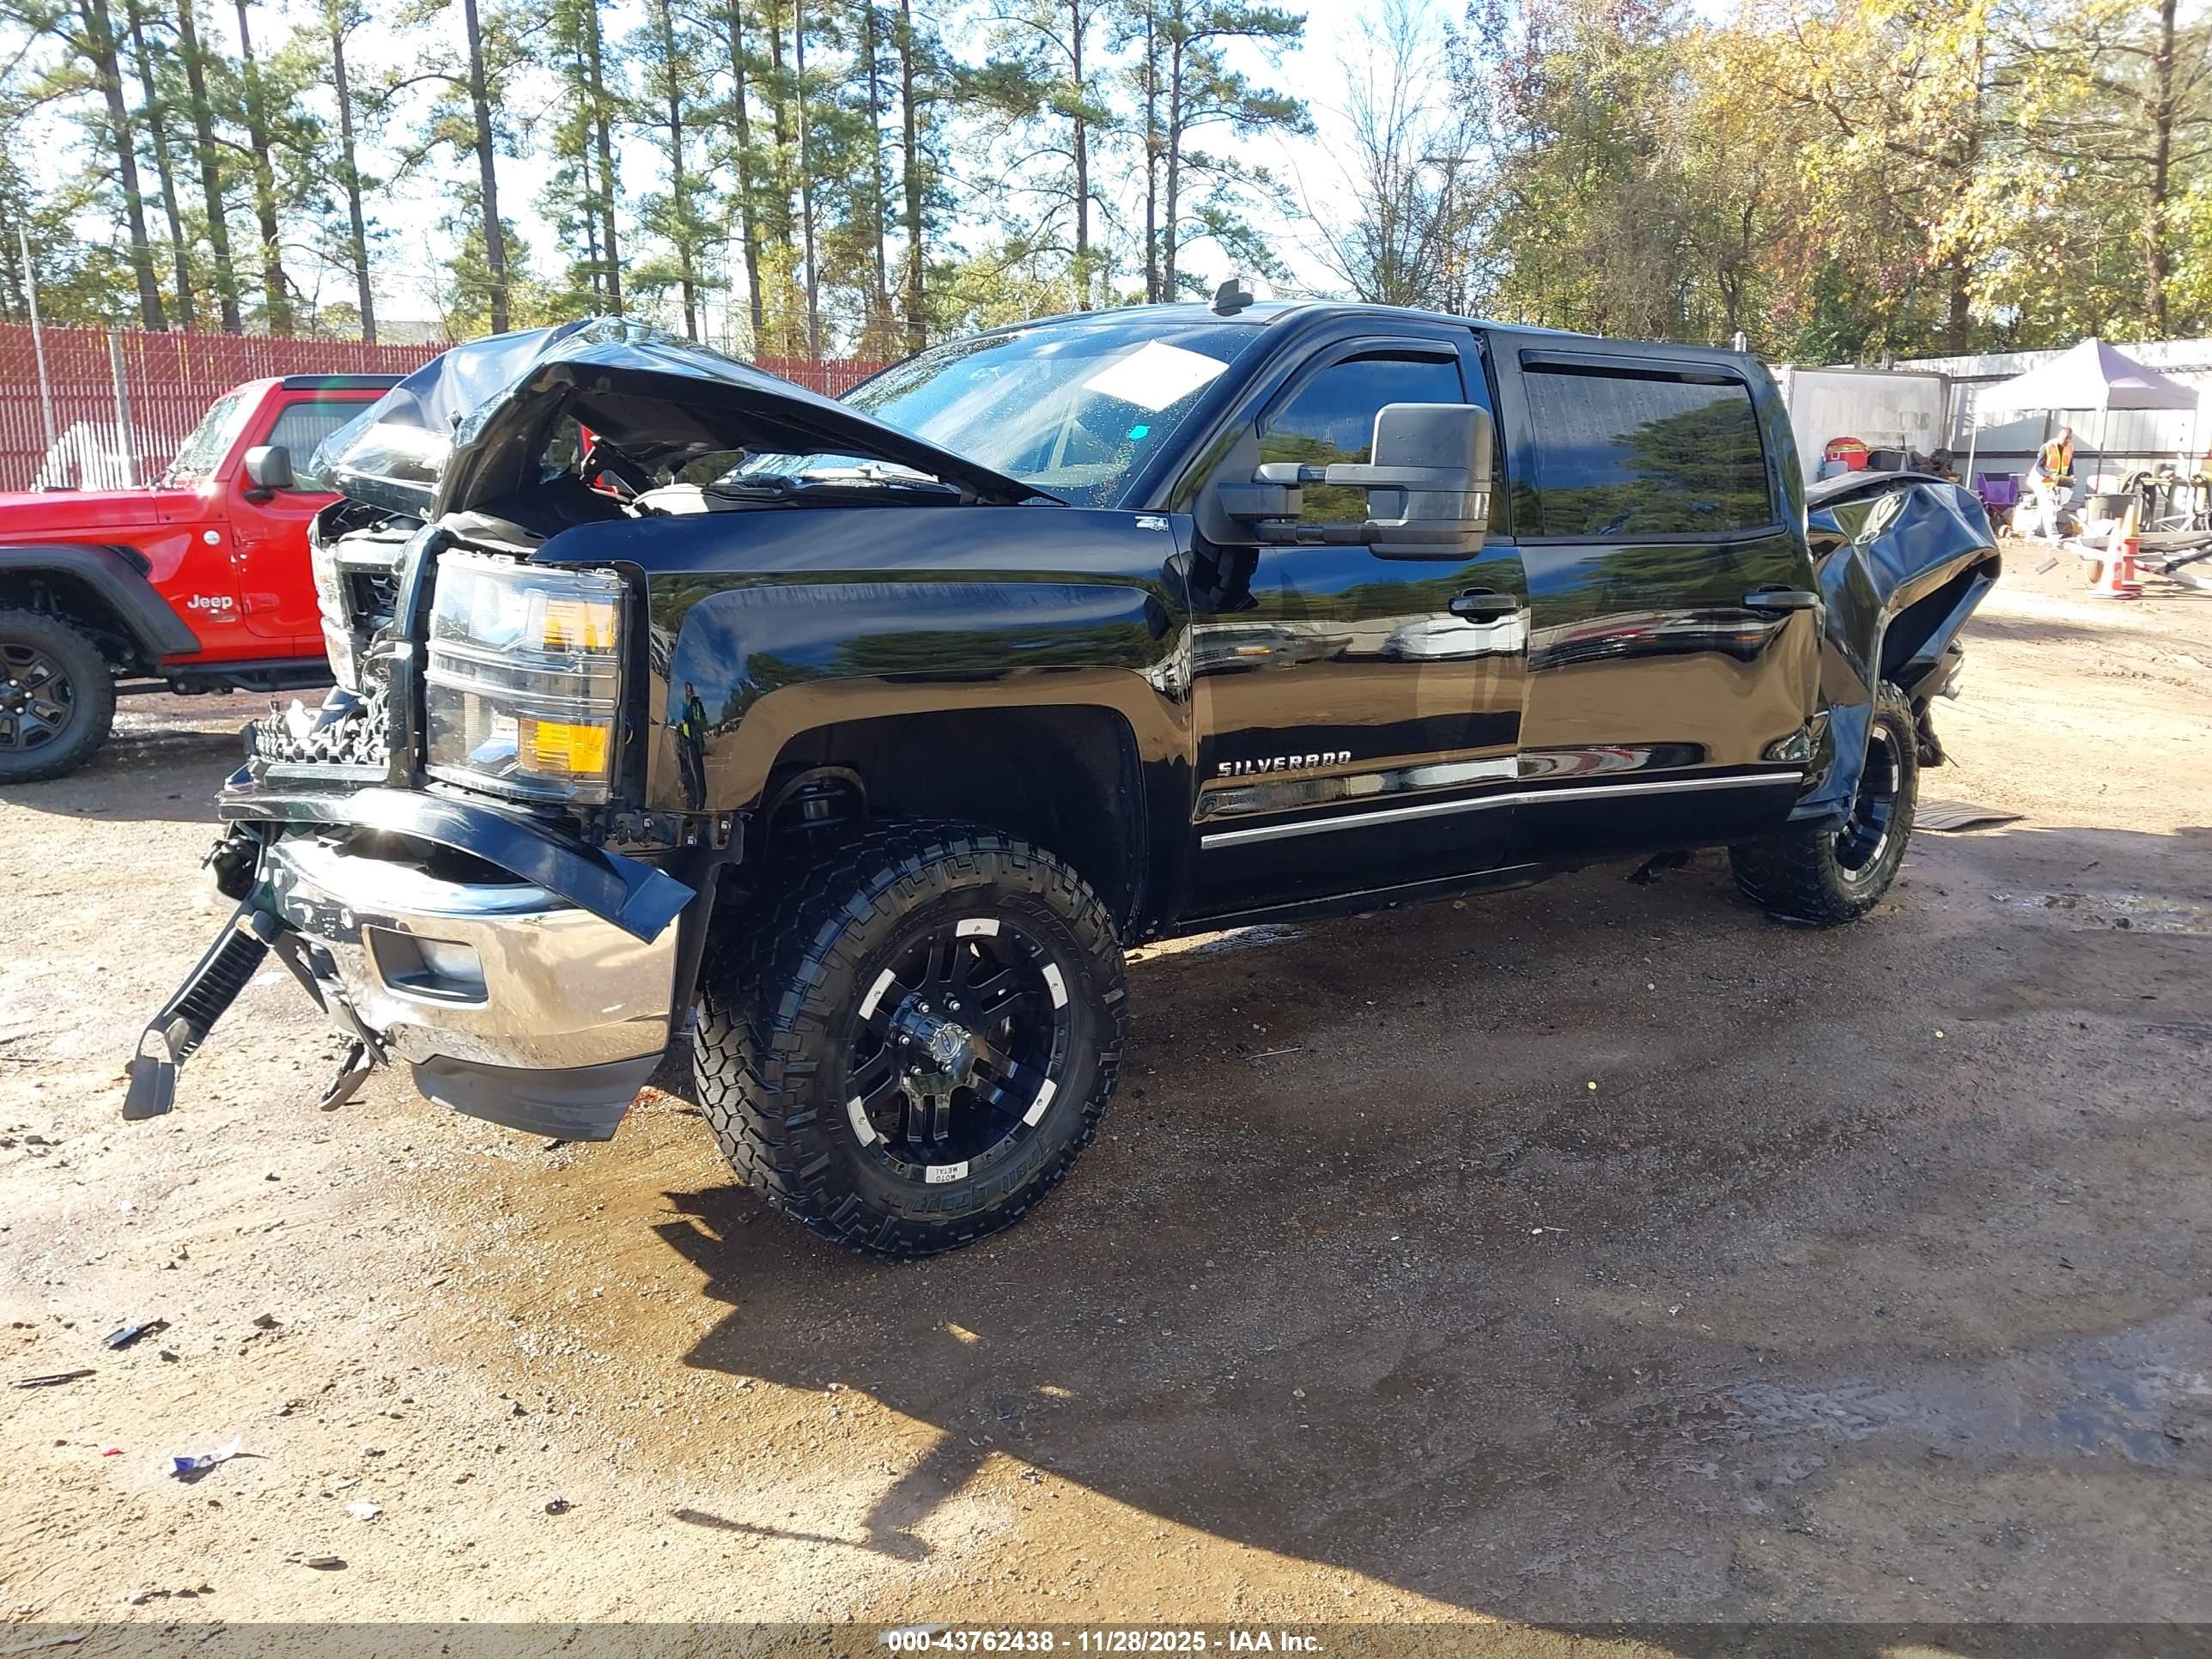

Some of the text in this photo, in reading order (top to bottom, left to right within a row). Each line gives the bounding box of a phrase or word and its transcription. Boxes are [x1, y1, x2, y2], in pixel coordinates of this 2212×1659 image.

[187, 594, 233, 610] Jeep
[1217, 750, 1352, 777] SILVERADO
[934, 1166, 958, 1175] METAL
[935, 1174, 957, 1182] MOTO
